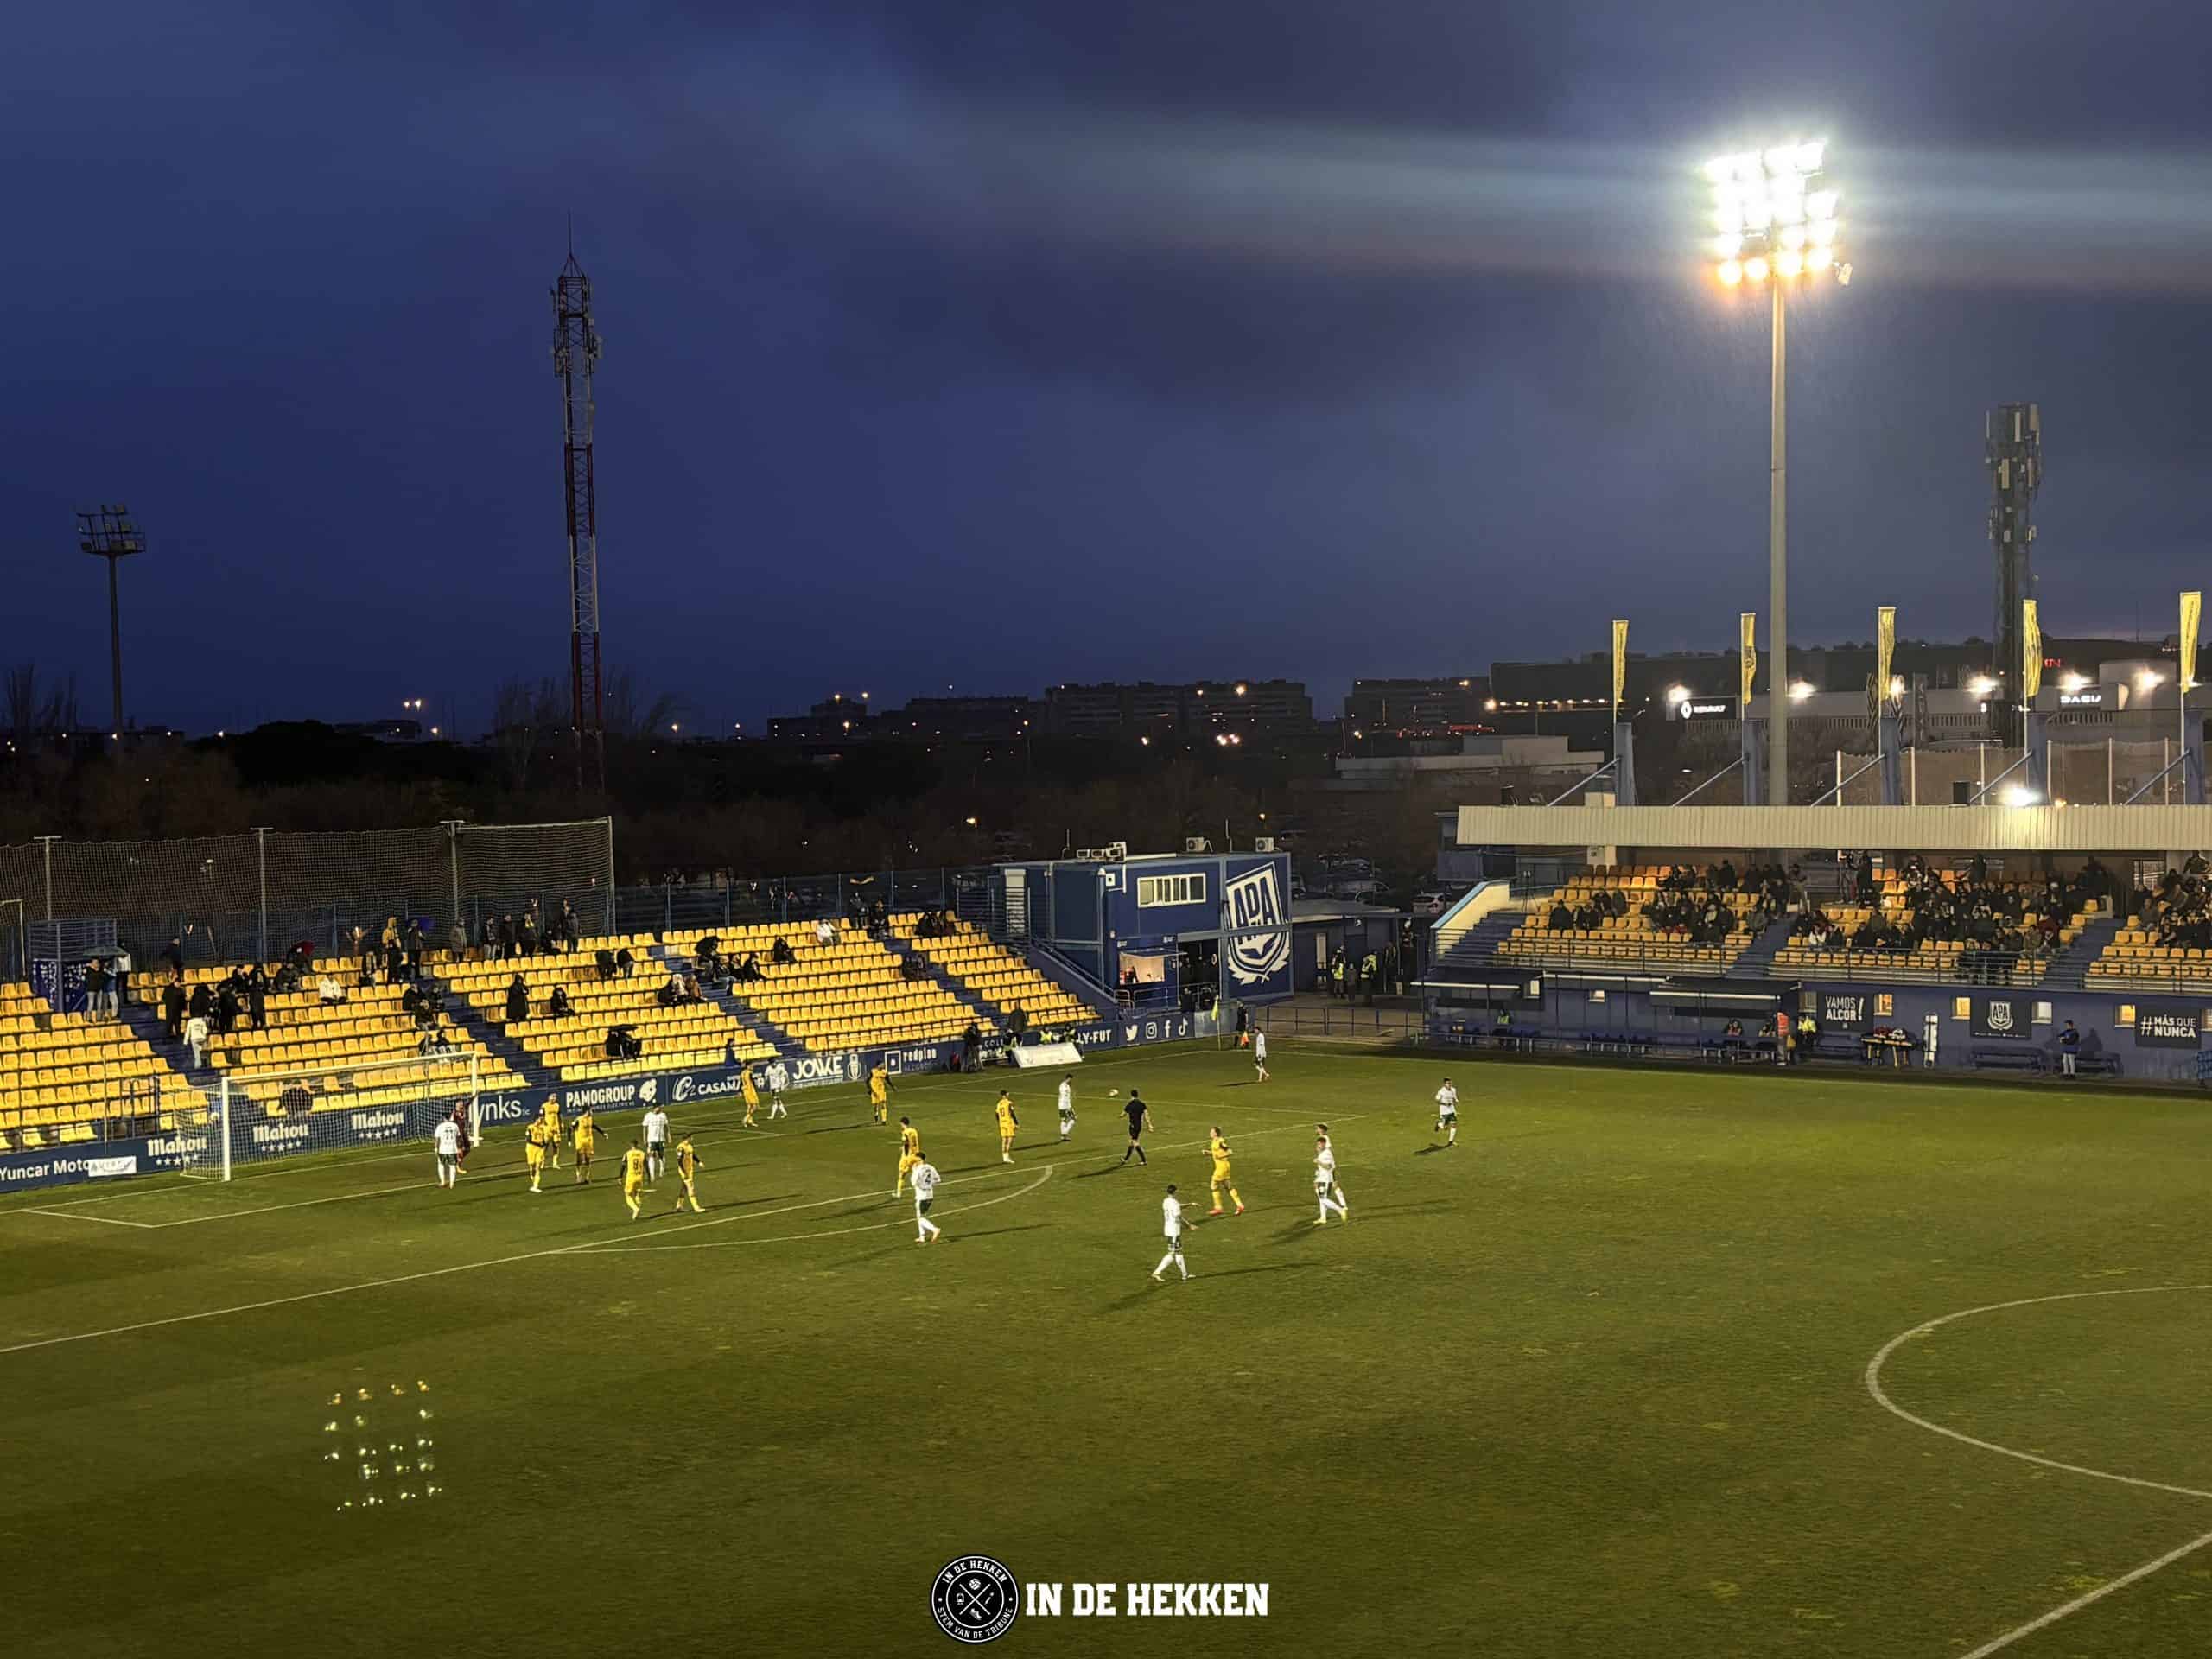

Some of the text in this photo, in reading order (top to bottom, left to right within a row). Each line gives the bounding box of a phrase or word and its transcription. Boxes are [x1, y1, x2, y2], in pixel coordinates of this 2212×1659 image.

[1825, 995, 1856, 1009] VAMOS
[2177, 1017, 2196, 1027] QUE
[2154, 1026, 2196, 1038] NUNCA
[566, 1085, 635, 1108] PAMOGROUP
[352, 1111, 404, 1129] Mahou
[253, 1123, 309, 1142] Mahou
[147, 1136, 207, 1156] Mahou
[0, 1164, 50, 1181] Yuncar
